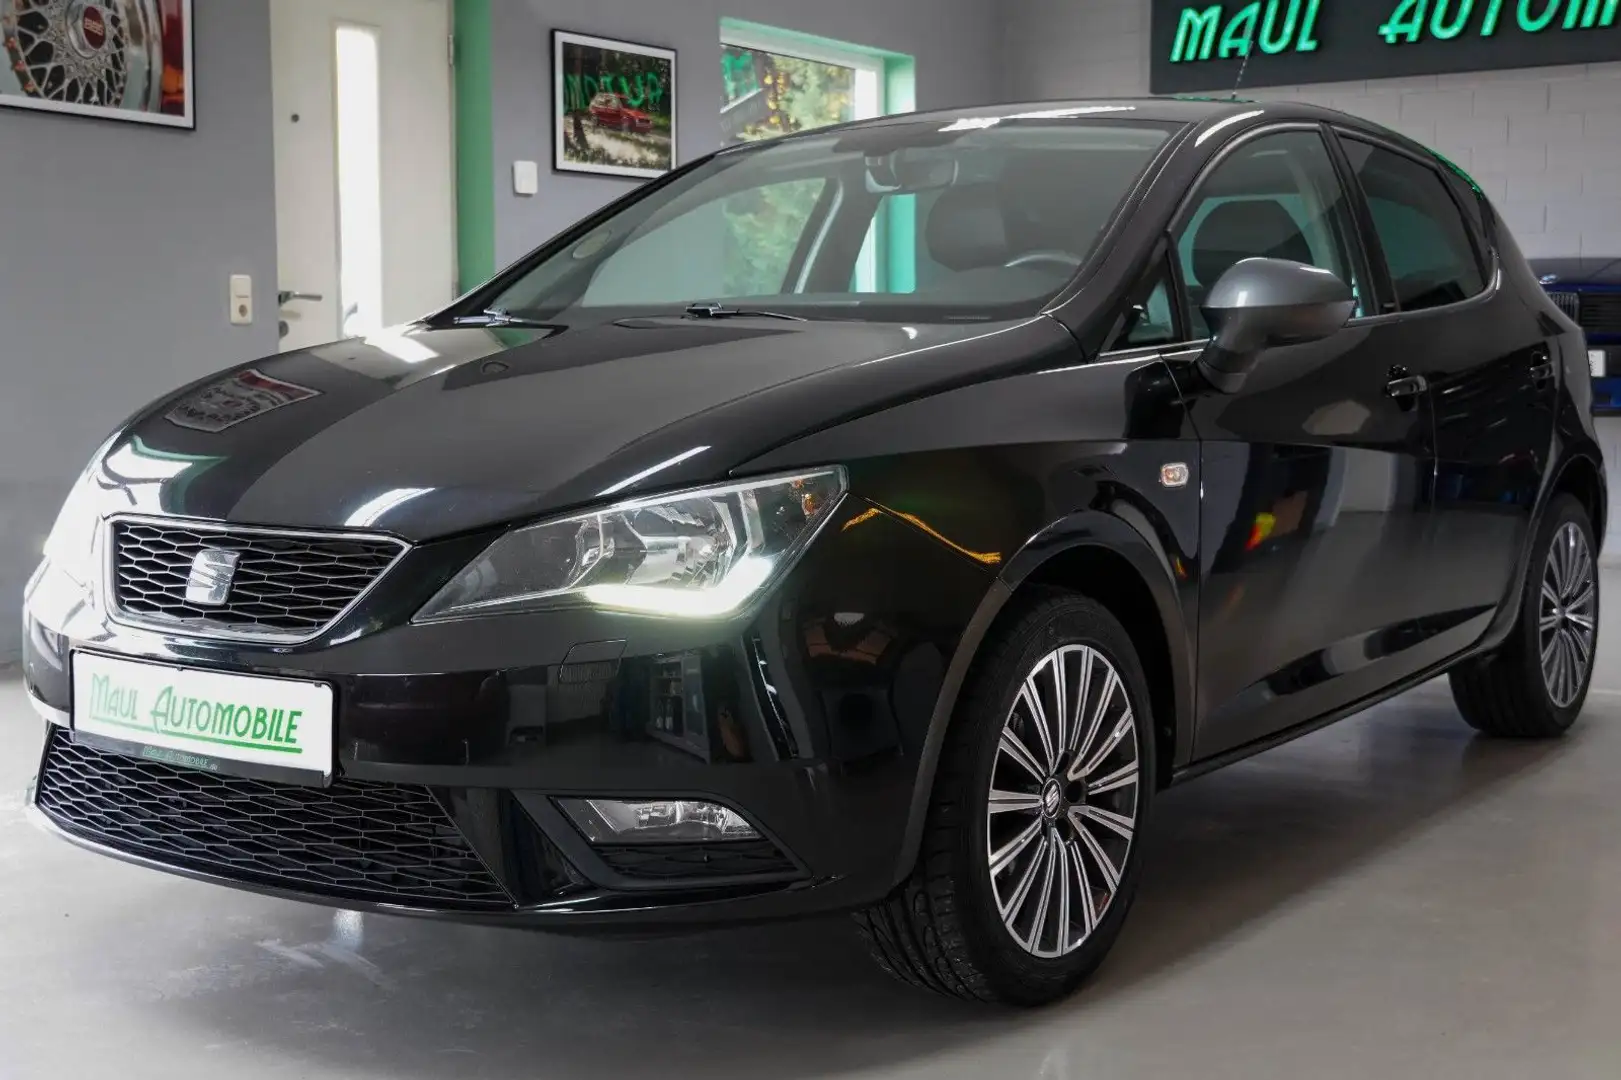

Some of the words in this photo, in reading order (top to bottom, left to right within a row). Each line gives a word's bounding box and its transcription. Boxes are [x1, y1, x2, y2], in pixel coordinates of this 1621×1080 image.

[1169, 0, 1319, 62] MAUL
[89, 673, 138, 720] MAUL
[150, 686, 303, 744] AUTOMOBILE
